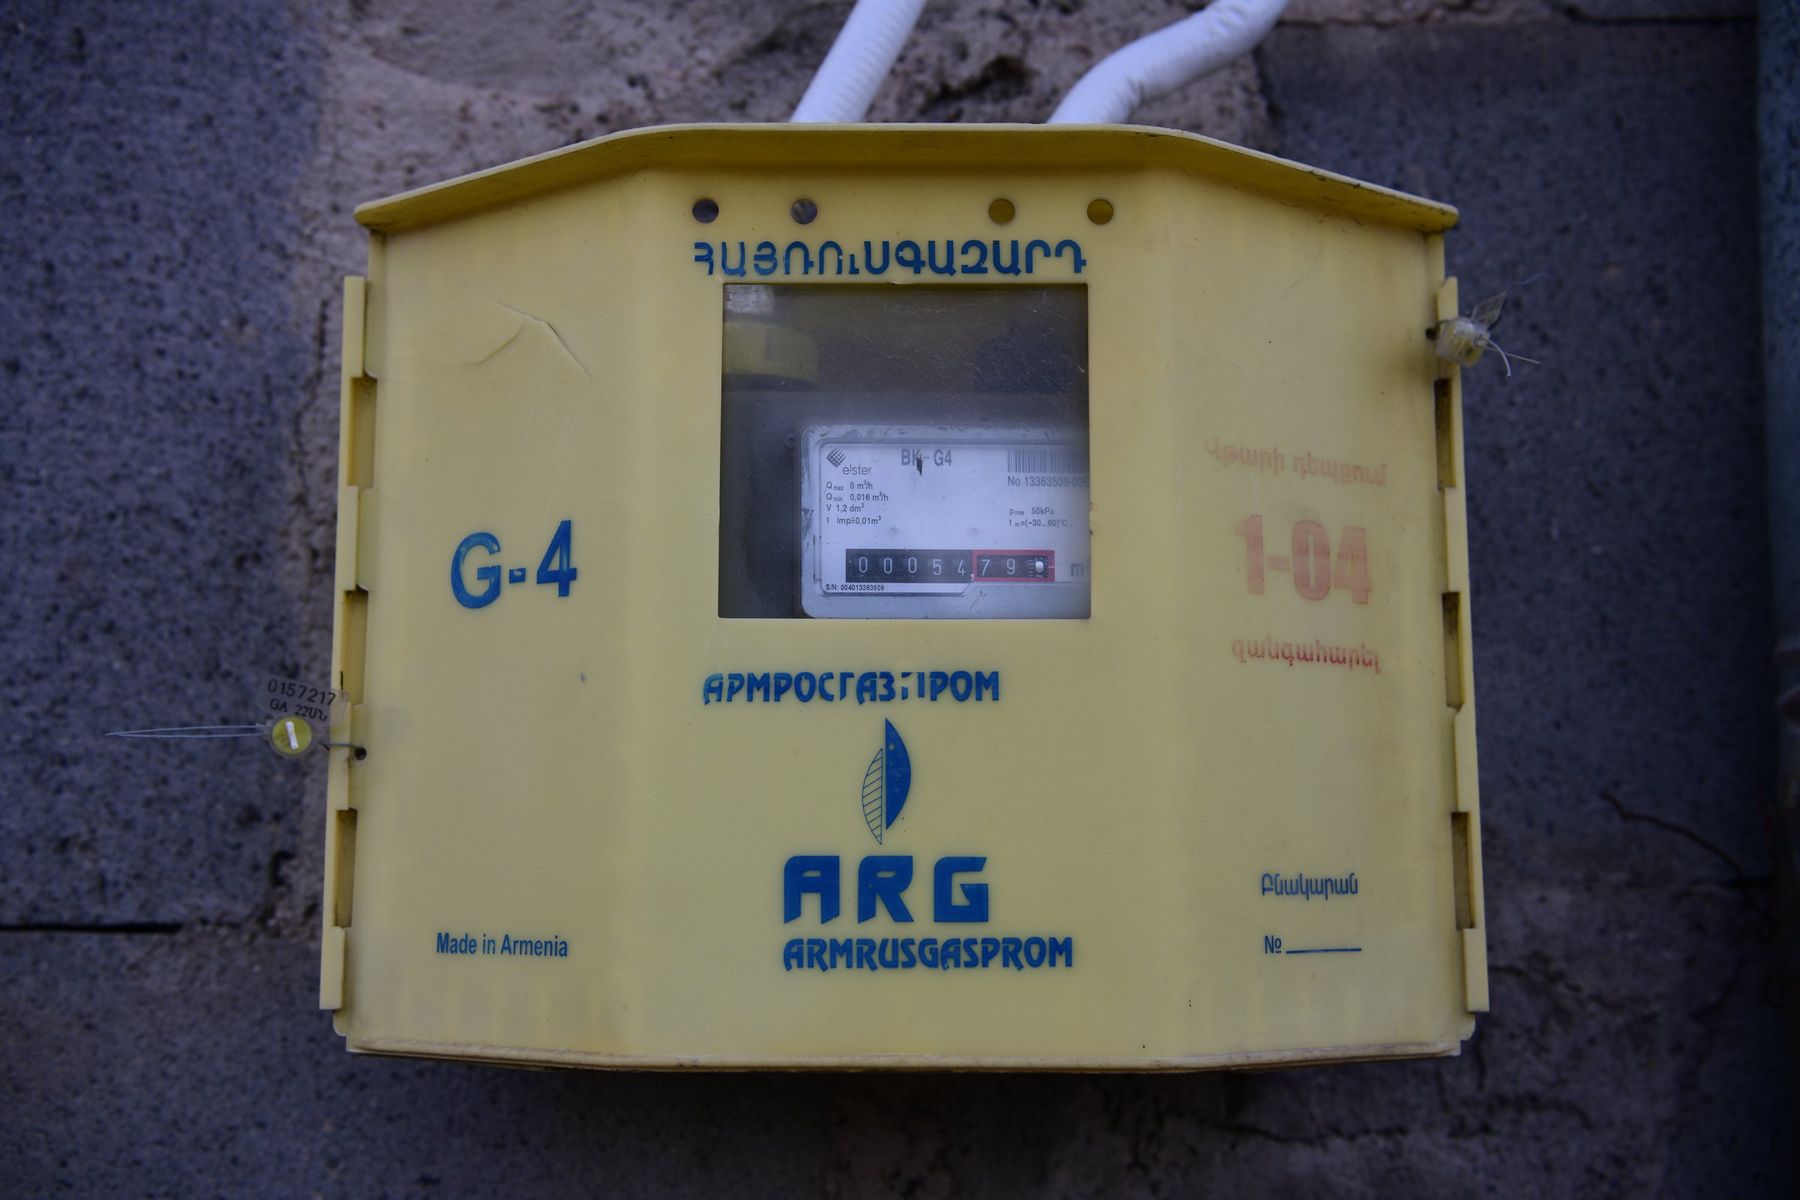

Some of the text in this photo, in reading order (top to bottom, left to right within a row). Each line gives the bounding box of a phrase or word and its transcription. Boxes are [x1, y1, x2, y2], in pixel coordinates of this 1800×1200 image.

[842, 464, 872, 475] elster
[1007, 476, 1021, 487] No
[826, 504, 832, 512] V
[836, 504, 848, 513] 1,2
[1031, 507, 1055, 516] 50kPa
[451, 519, 577, 609] G-4
[1234, 513, 1374, 605] 1-04
[1232, 635, 1382, 674] զանգահարել
[267, 679, 336, 706] 0157217
[270, 698, 288, 713] GA
[784, 856, 989, 924] ARG
[1261, 873, 1358, 901] Բնակարան
[436, 932, 568, 957] Made in Armenia
[784, 937, 1073, 972] ARMRUSGASPROM
